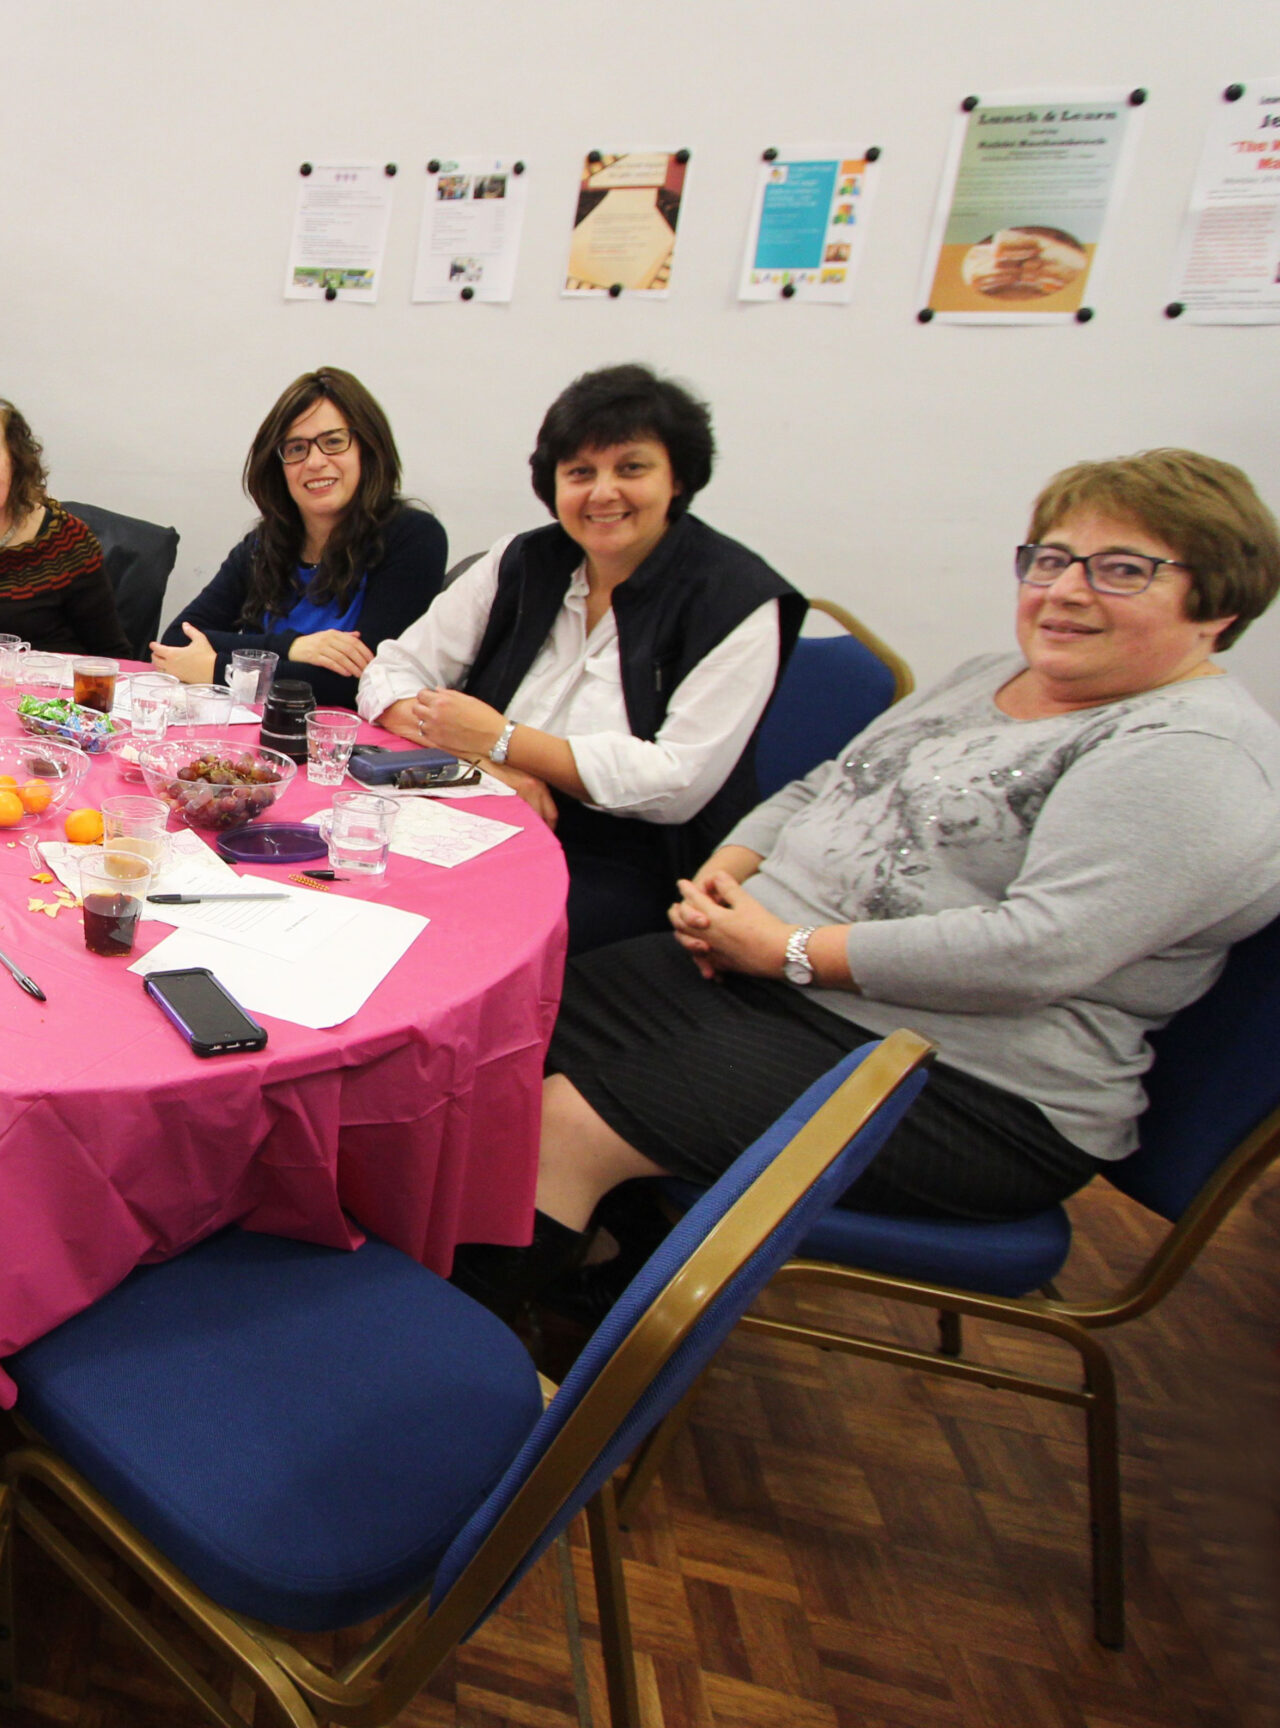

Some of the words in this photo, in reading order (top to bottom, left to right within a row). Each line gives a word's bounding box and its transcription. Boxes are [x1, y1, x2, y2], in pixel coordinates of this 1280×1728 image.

[978, 111, 1038, 125] Lunch
[1042, 110, 1056, 122] &
[1060, 109, 1118, 122] Learn
